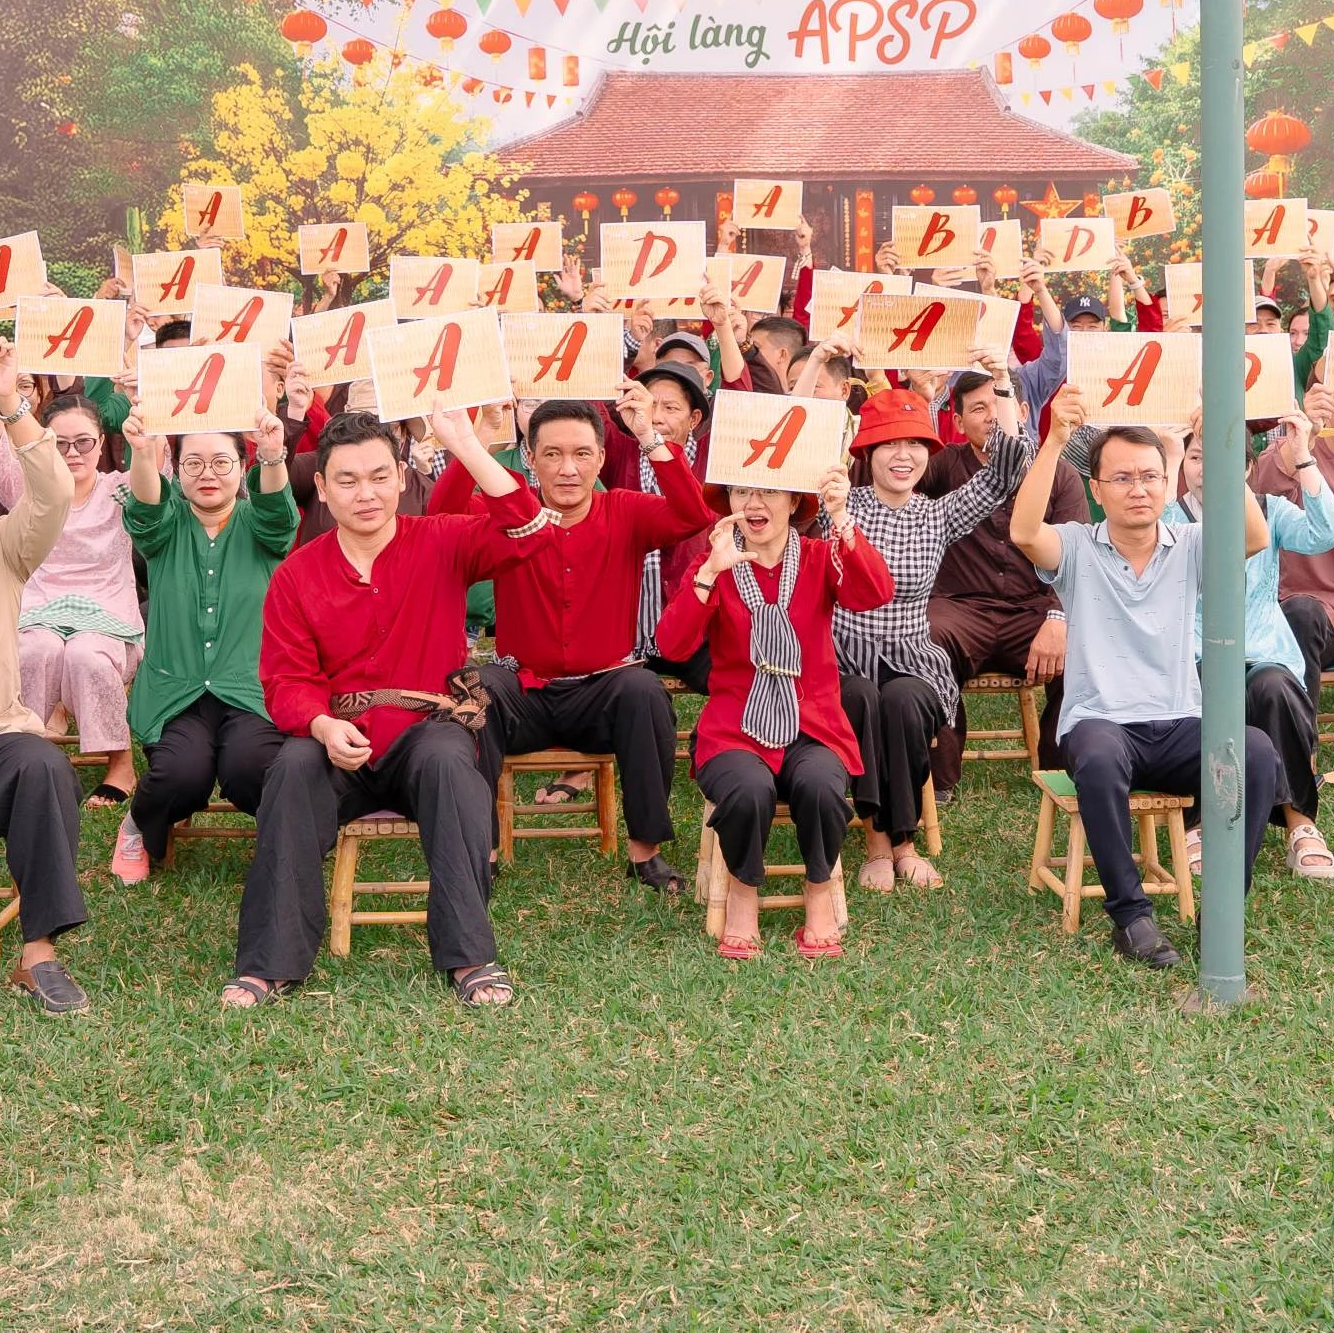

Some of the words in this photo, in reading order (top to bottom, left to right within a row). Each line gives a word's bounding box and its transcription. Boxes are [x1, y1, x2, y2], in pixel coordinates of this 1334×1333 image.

[607, 21, 676, 65] Hội
[689, 14, 771, 69] làng
[197, 191, 223, 229] A
[752, 185, 783, 219] A
[1125, 195, 1154, 232] B
[1253, 204, 1286, 245] A
[319, 227, 348, 263] A
[512, 227, 542, 261] A
[916, 212, 956, 258] B
[1063, 226, 1096, 262] D
[159, 255, 196, 302] A
[629, 231, 678, 287] D
[731, 261, 764, 298] A
[415, 263, 453, 305] A
[484, 267, 514, 306] A
[43, 305, 95, 359] A
[216, 296, 264, 343] A
[324, 311, 365, 371] A
[888, 300, 948, 353] A
[412, 322, 462, 399] A
[533, 320, 588, 383] A
[1102, 341, 1163, 407] A
[172, 353, 225, 416] A
[742, 405, 807, 470] A
